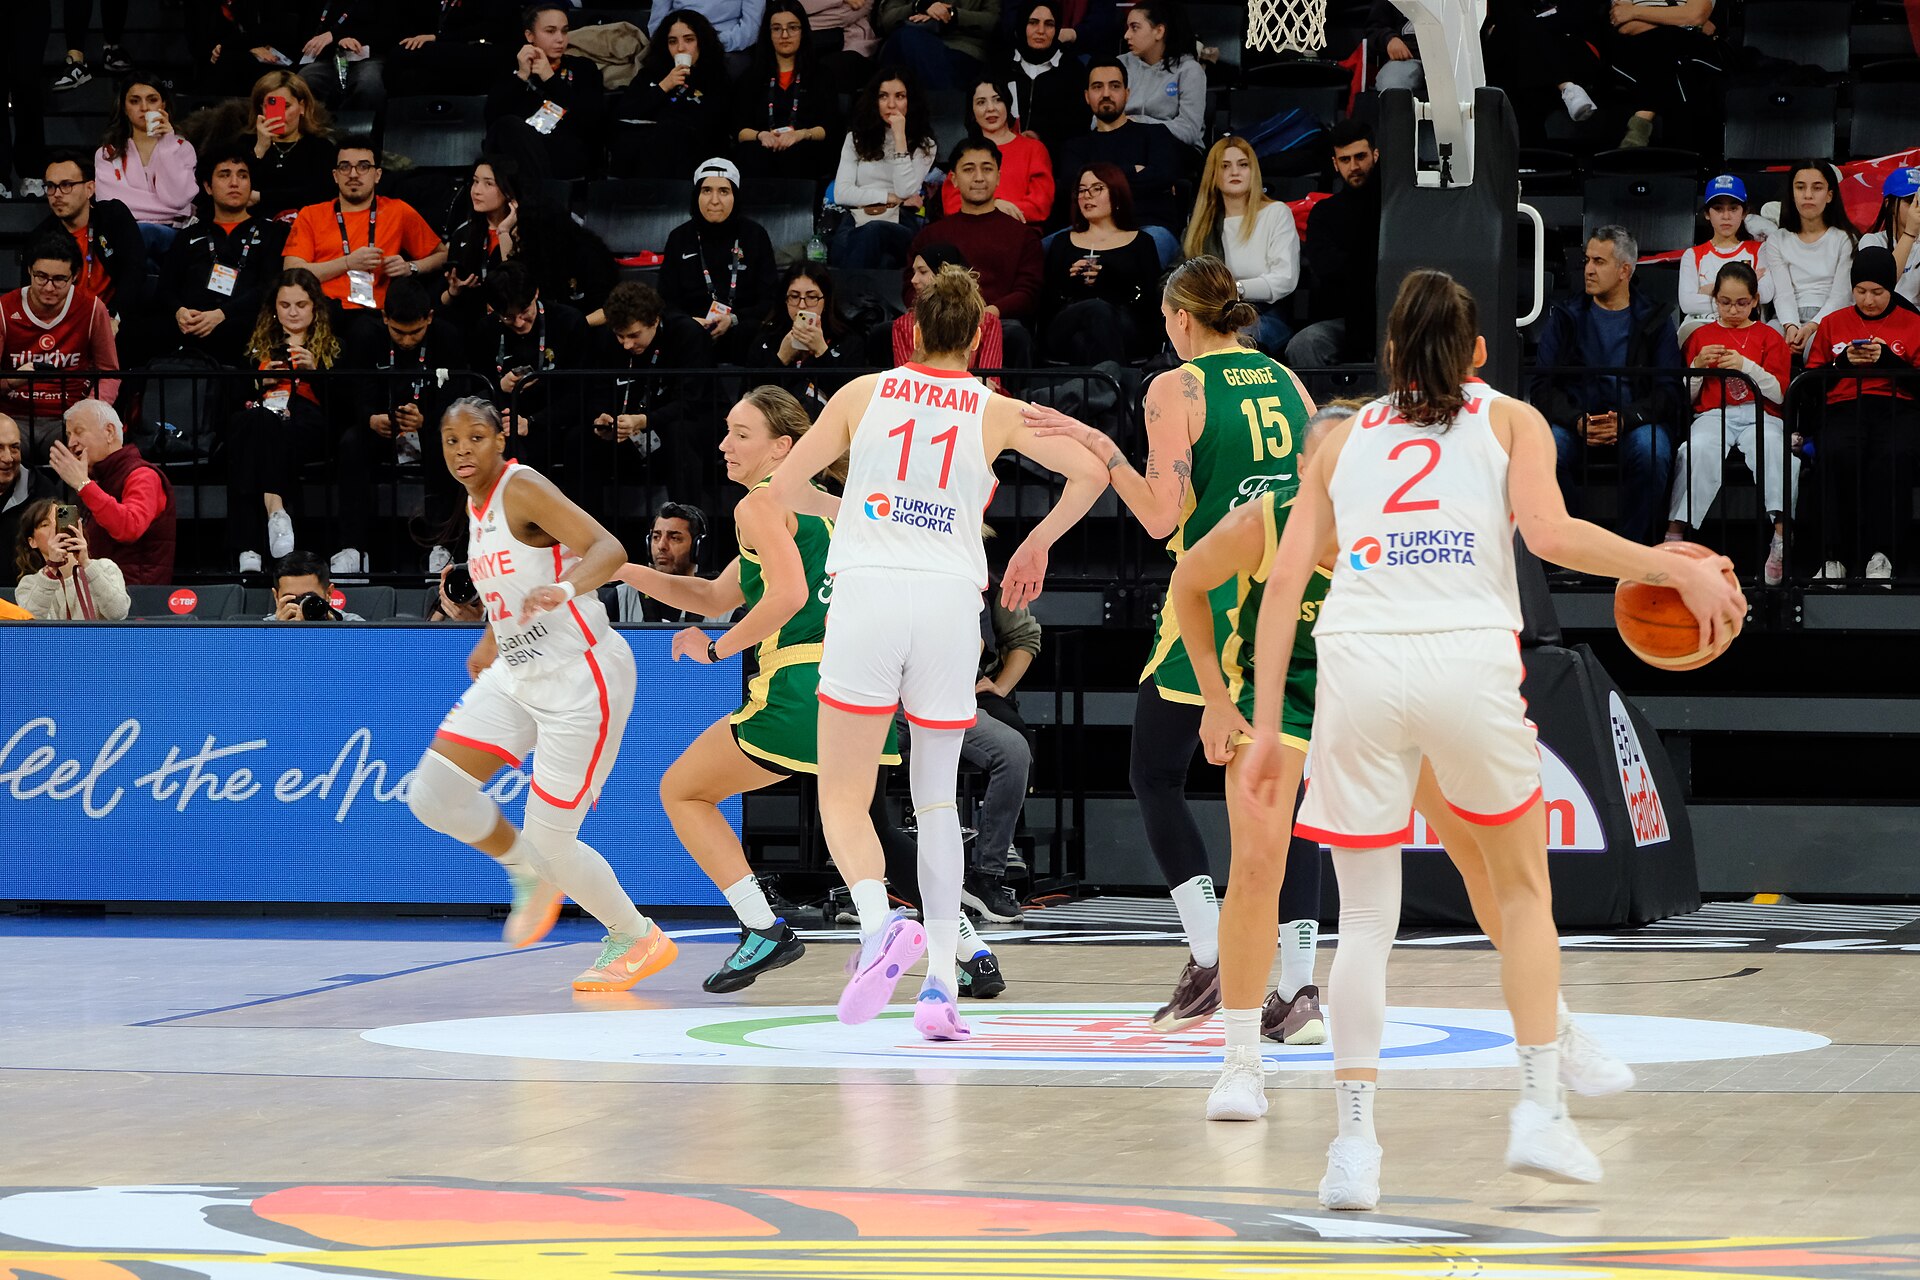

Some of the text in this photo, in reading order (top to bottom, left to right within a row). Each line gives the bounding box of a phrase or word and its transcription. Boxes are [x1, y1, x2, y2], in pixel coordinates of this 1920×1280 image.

[880, 377, 979, 415] BAYRAM
[1222, 366, 1278, 387] GEORGE
[1240, 396, 1293, 461] 15
[1361, 397, 1483, 429] UZN
[888, 418, 959, 490] 11
[1382, 438, 1442, 514] 2
[498, 621, 548, 652] Garnti
[133, 734, 268, 812] the
